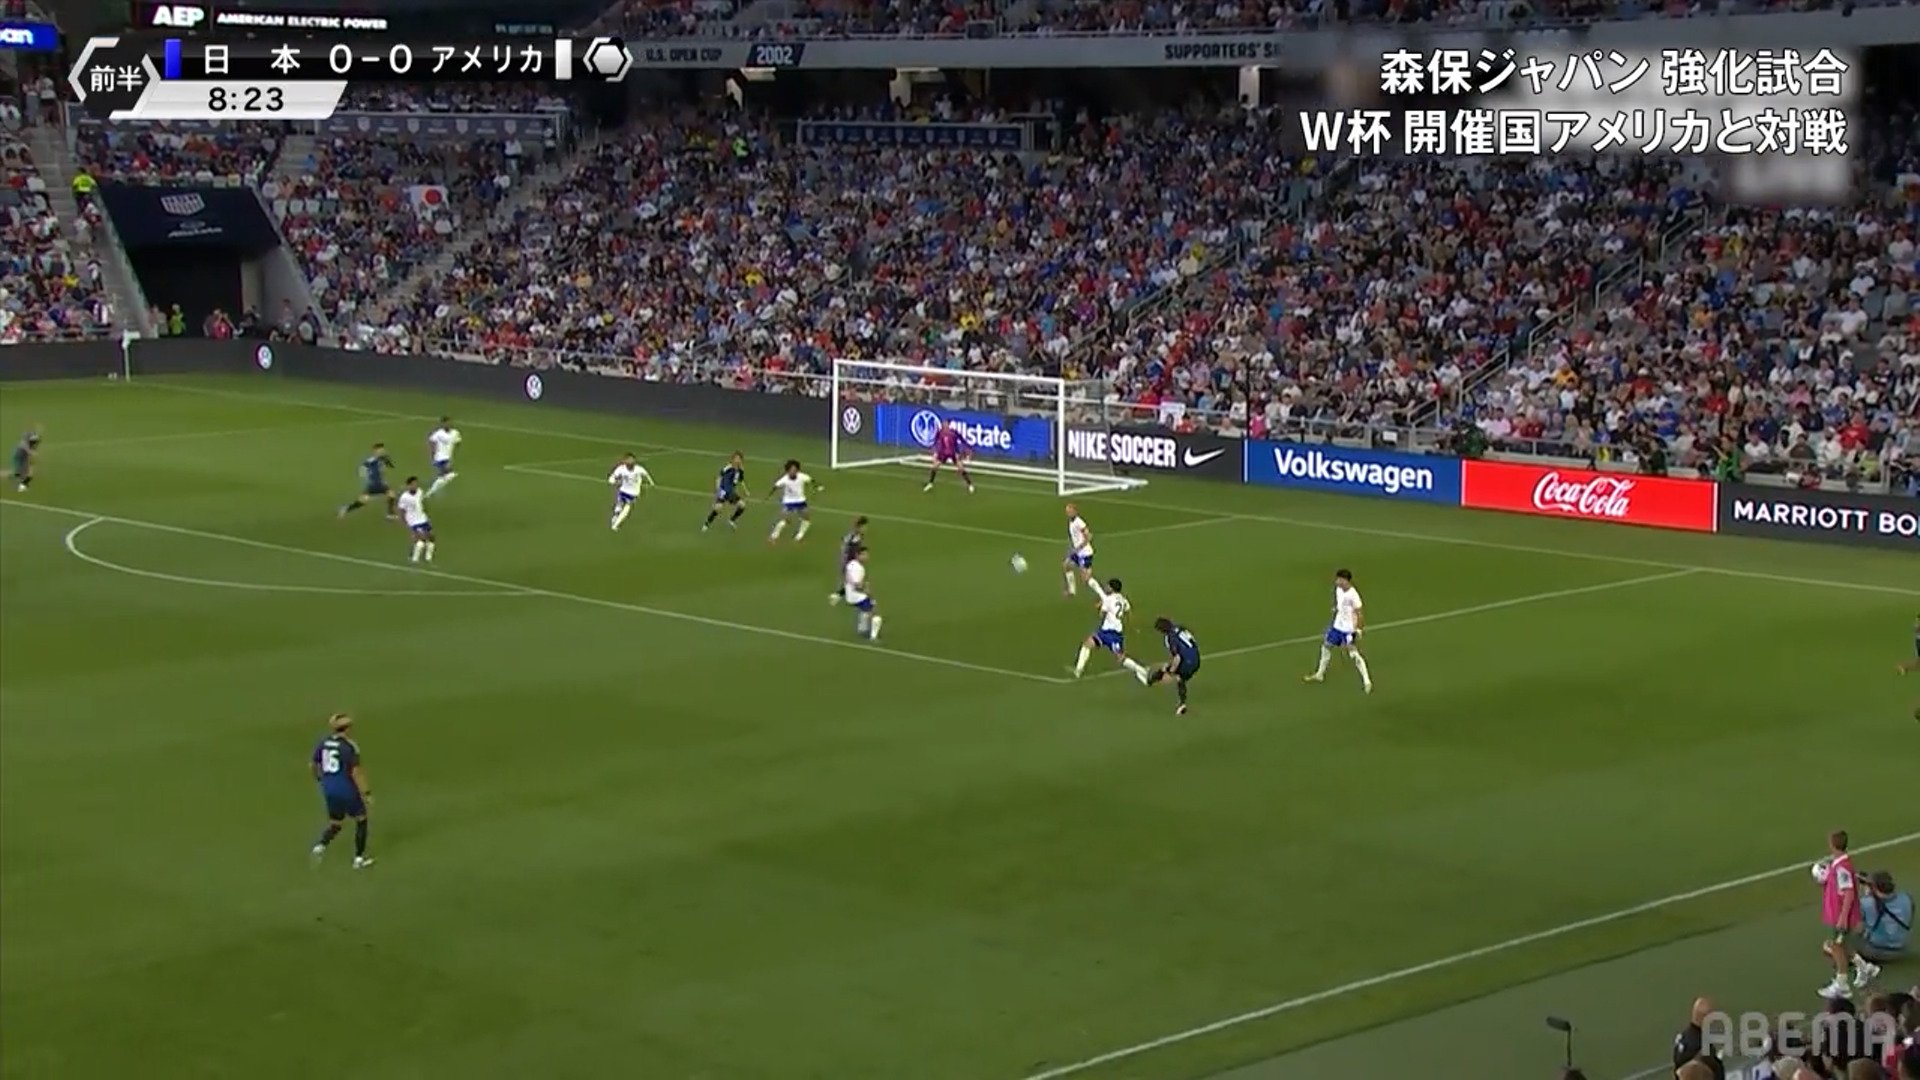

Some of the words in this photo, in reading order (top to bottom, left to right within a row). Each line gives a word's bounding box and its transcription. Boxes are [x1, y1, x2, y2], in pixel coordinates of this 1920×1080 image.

[152, 5, 205, 26] AEP
[217, 13, 284, 26] AMERICAN
[287, 16, 340, 28] ELECTRIC
[343, 18, 388, 30] POWER
[756, 46, 793, 64] 2002
[1068, 430, 1107, 461] NIKE
[1110, 433, 1176, 467] SOCCER
[1274, 447, 1433, 494] Volkswagen
[1733, 500, 1868, 532] MARRIOTT
[1879, 512, 1920, 537] BO
